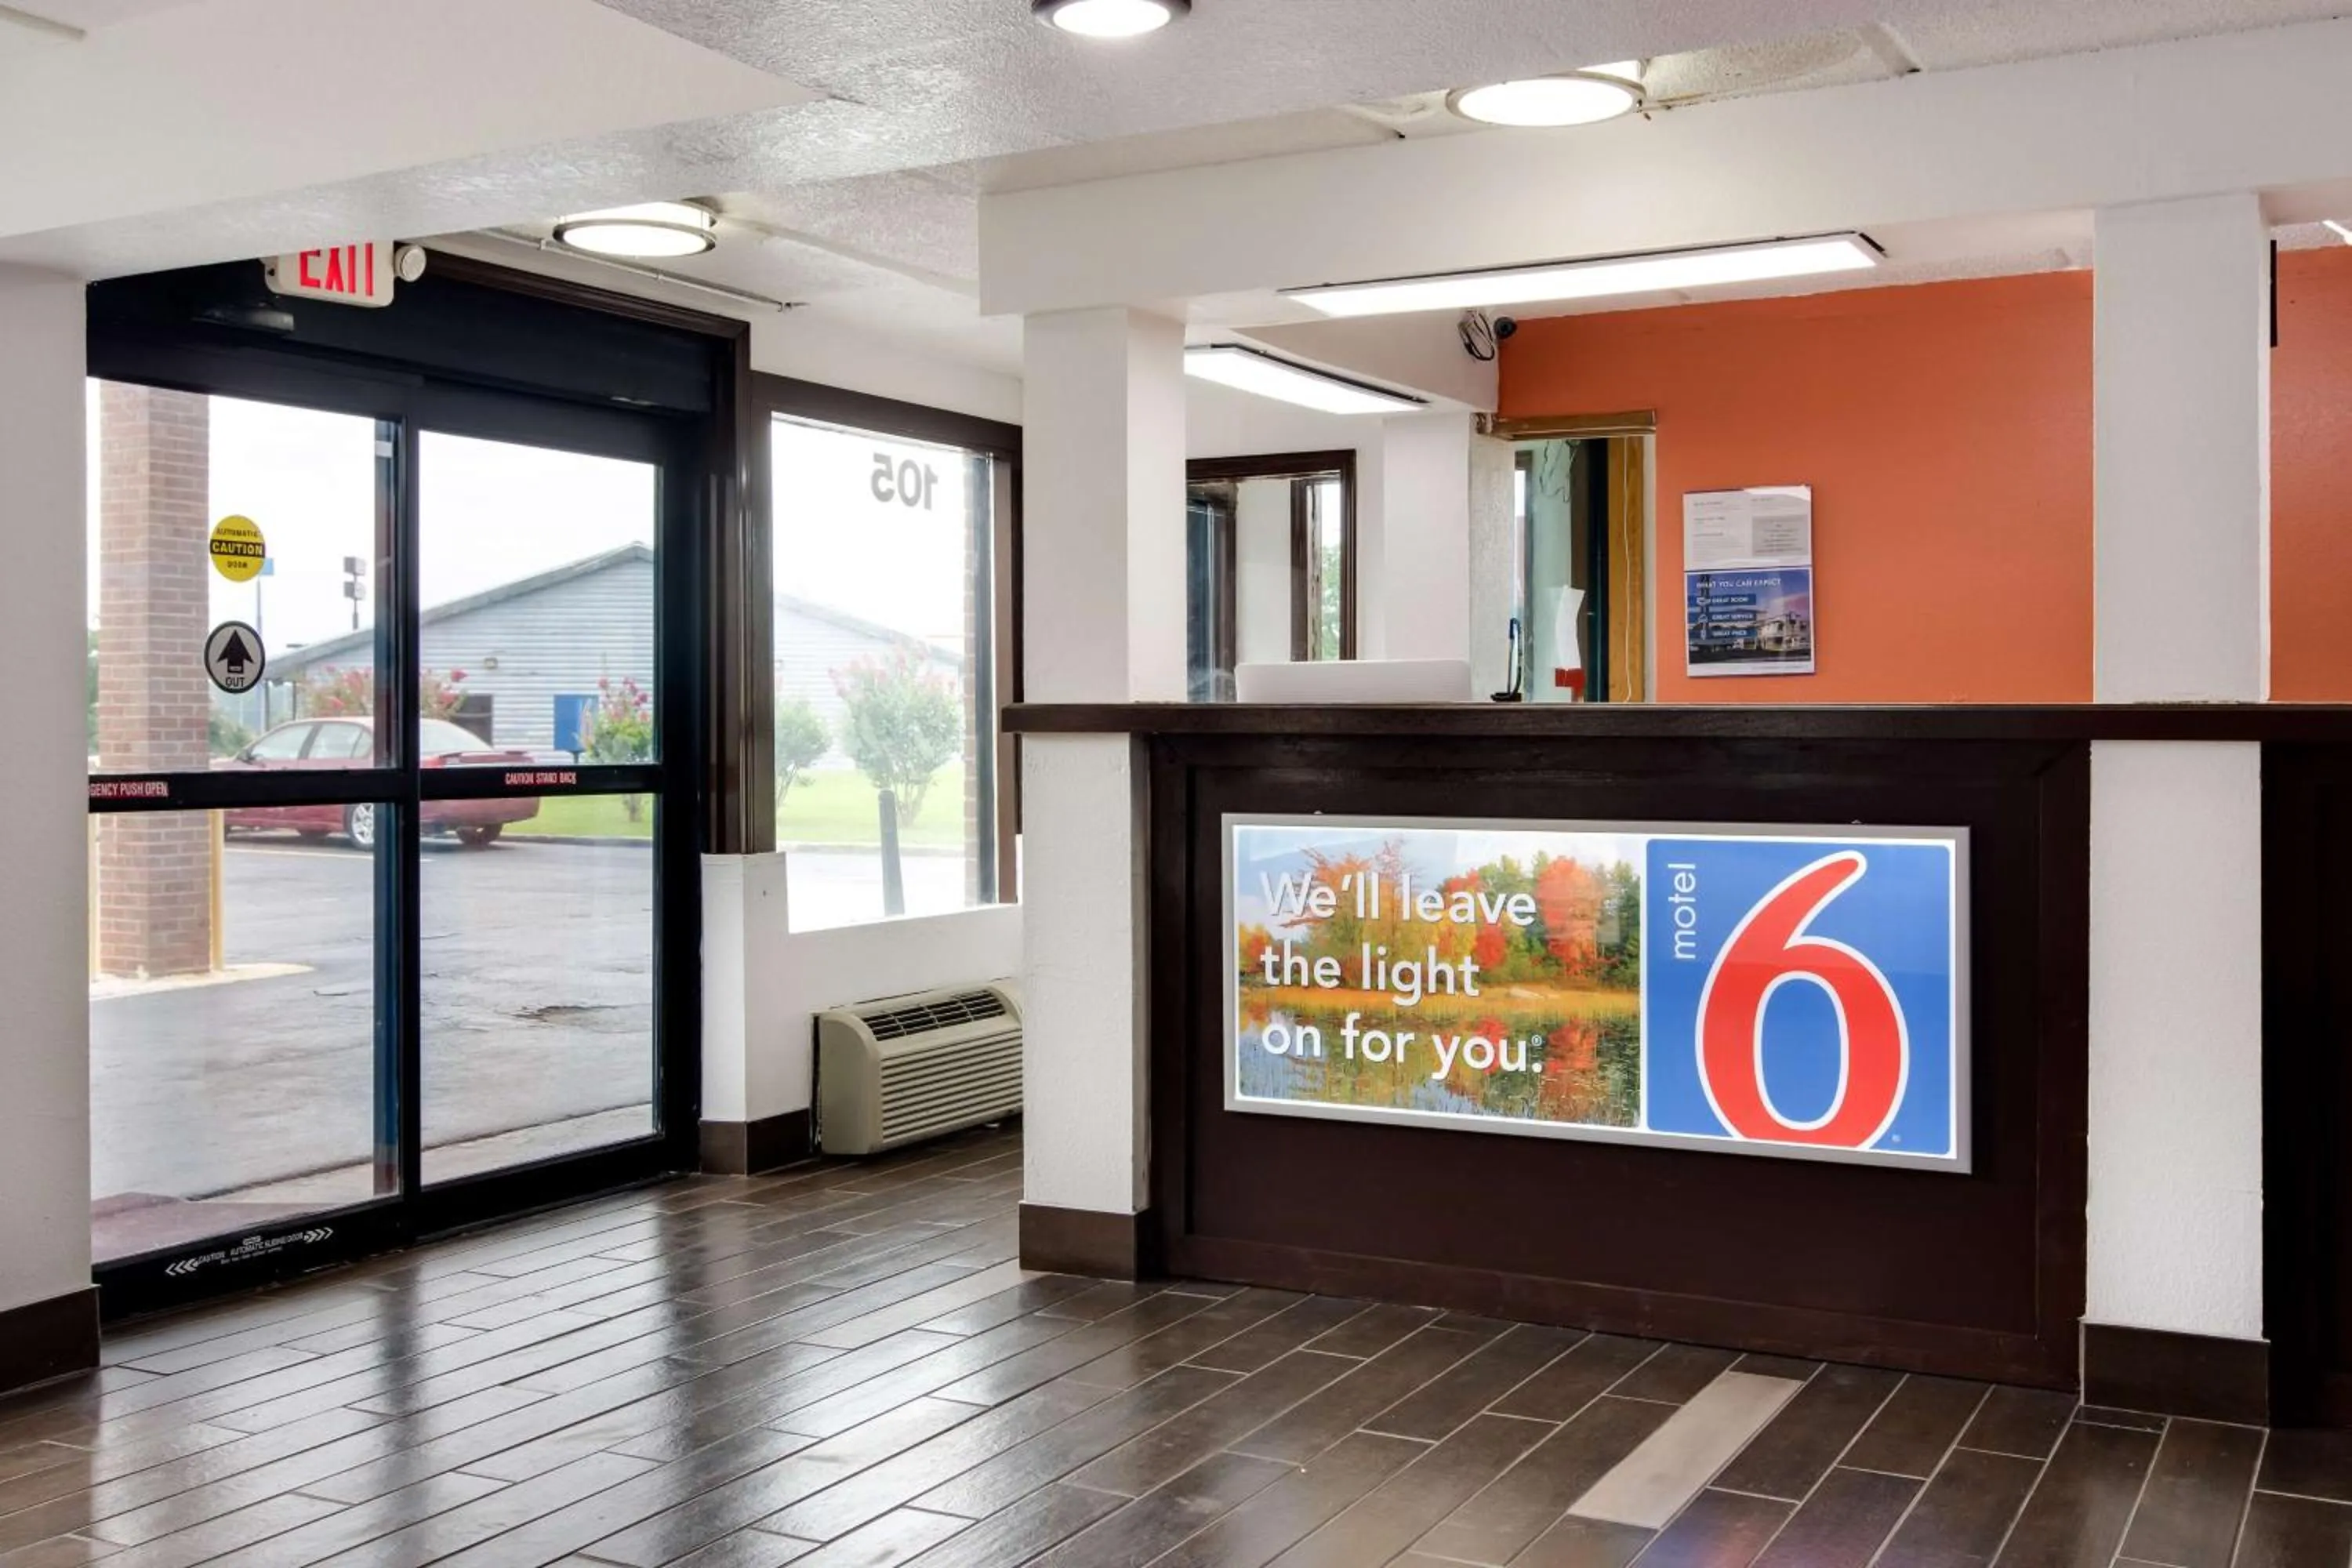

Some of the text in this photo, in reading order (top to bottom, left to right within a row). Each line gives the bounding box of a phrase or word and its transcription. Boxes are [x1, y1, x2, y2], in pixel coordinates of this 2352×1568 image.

[212, 541, 263, 556] CAUTION
[225, 676, 245, 688] OUT
[89, 781, 169, 797] GENCY PUSH OPEN
[1402, 873, 1537, 926] leave
[1668, 863, 1697, 960] motel
[1260, 940, 1480, 1006] the light
[1695, 850, 1910, 1150] 6
[1261, 1022, 1321, 1058] on
[1340, 1012, 1415, 1063] for
